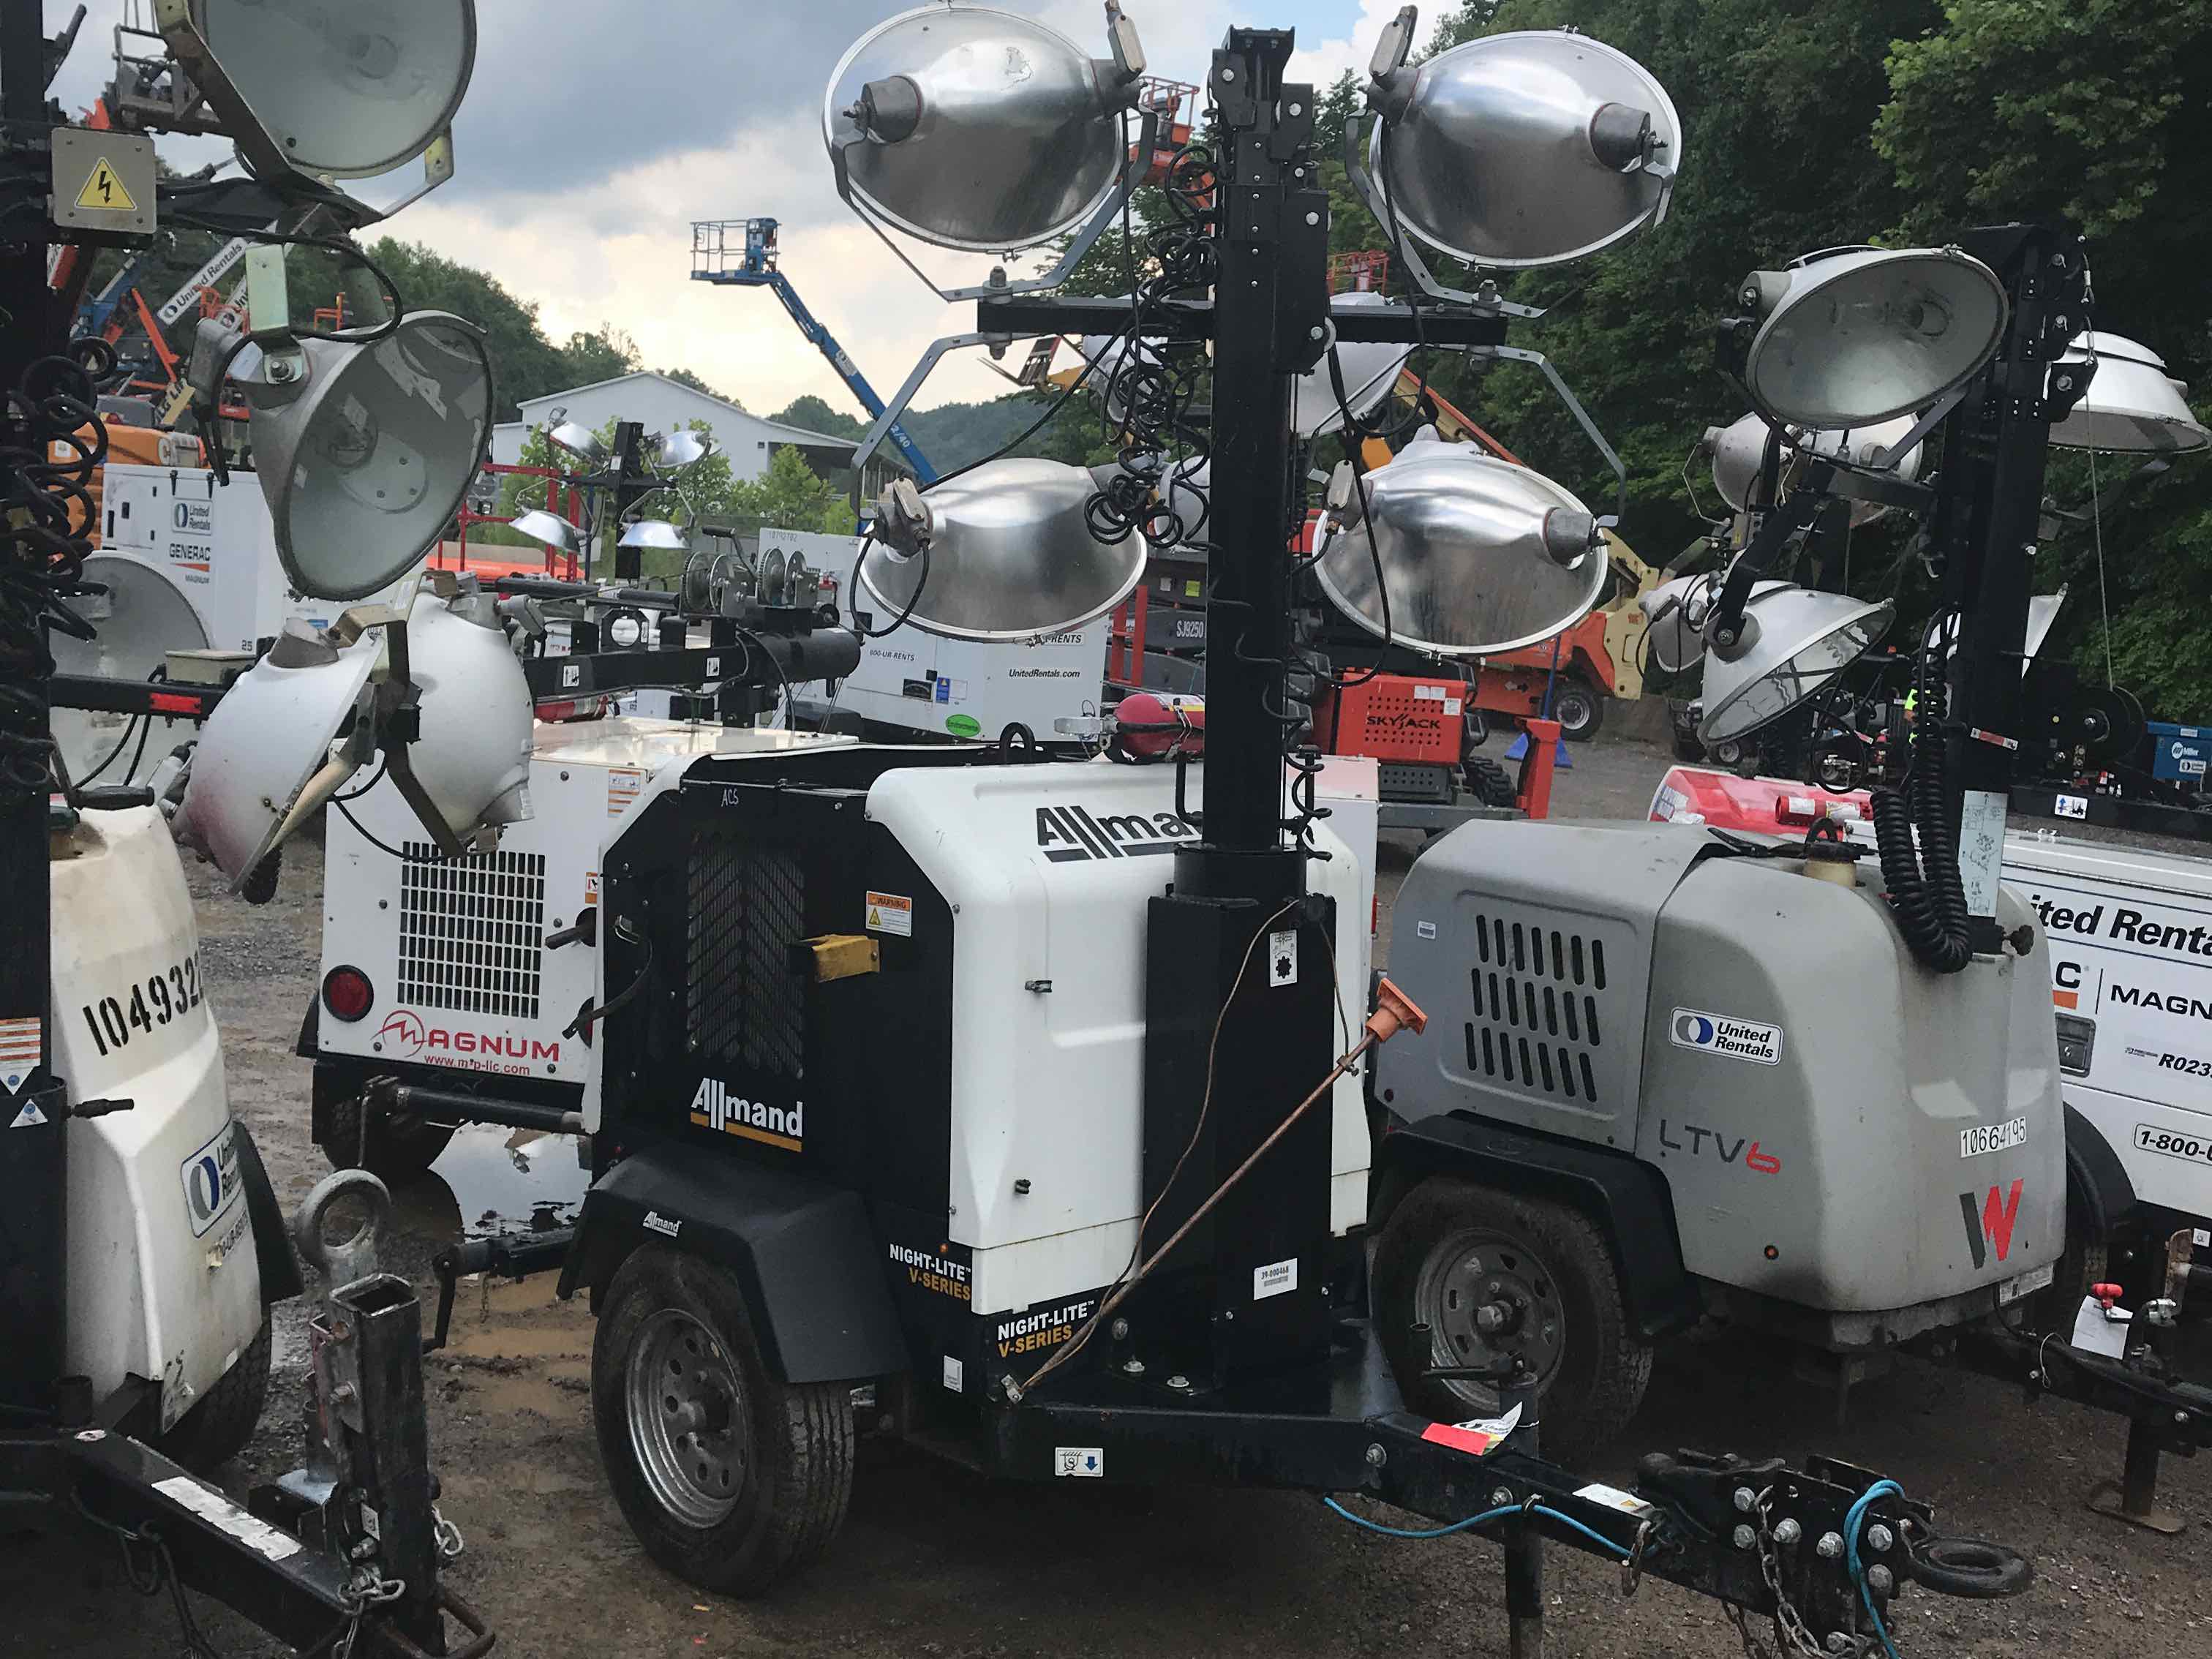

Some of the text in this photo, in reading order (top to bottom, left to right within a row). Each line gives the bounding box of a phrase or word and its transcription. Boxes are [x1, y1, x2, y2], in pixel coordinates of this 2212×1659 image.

[207, 244, 243, 278] Rentals
[169, 543, 211, 562] GENERAC
[1176, 620, 1204, 639] SJ9250
[1009, 669, 1081, 678] UnitedRentals.com
[1366, 713, 1440, 730] SKYJACK
[1718, 1021, 1772, 1043] United
[1715, 1036, 1774, 1058] Rentals
[2159, 1053, 2212, 1078] R023
[691, 1077, 803, 1137] Allmand
[1660, 1119, 1780, 1175] LTV6
[1962, 1118, 2025, 1155] 10664195
[644, 1211, 680, 1233] Allmand
[909, 1266, 971, 1301] V-SERIES
[998, 1325, 1073, 1358] V-SERIES
